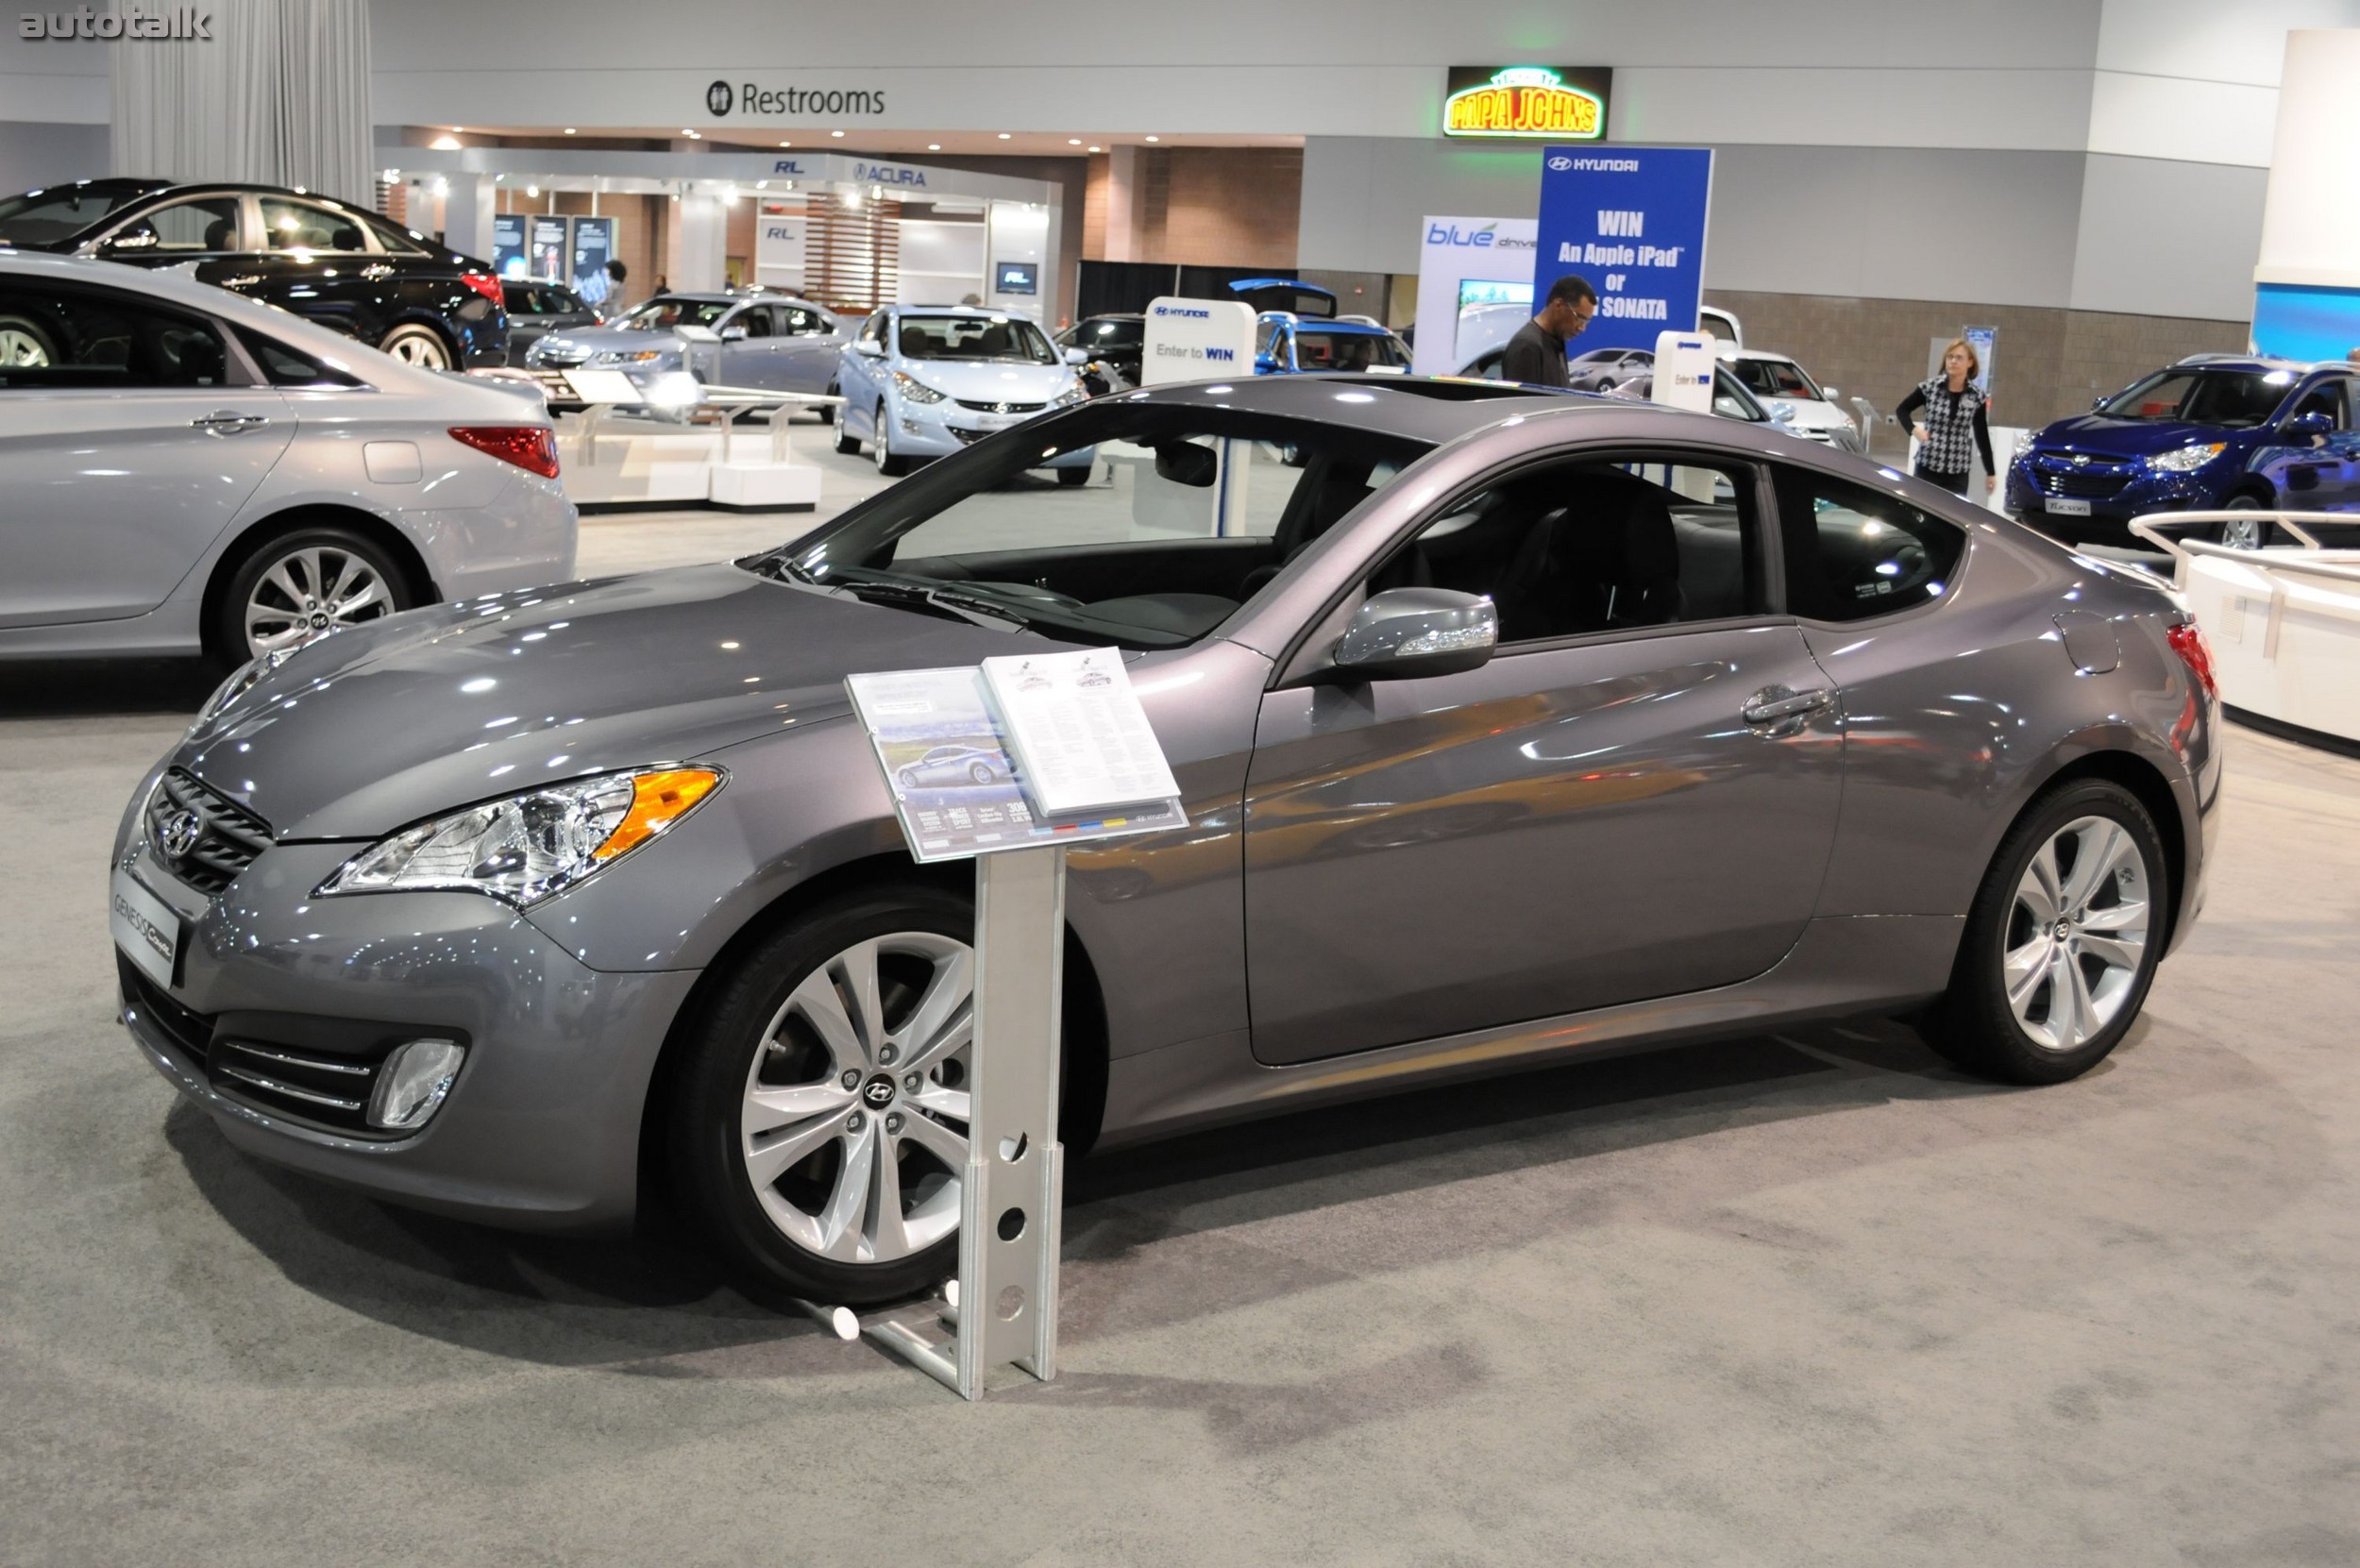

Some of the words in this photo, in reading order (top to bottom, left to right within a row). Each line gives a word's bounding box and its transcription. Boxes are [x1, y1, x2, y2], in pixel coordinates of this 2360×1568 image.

[742, 83, 885, 114] Restrooms
[1449, 89, 1513, 130] PAPA
[774, 160, 805, 174] RL
[868, 165, 927, 187] ACURA
[1573, 159, 1639, 172] HYUNDAI
[767, 228, 796, 240] RL
[1426, 223, 1495, 246] blue
[1597, 210, 1644, 238] WIN
[1558, 242, 1582, 263] An
[1583, 243, 1635, 267] Apple
[1605, 273, 1627, 292] or
[1602, 296, 1668, 320] SONATA
[1156, 343, 1188, 358] Enter
[1190, 347, 1204, 359] to
[1205, 346, 1234, 362] WIN
[114, 893, 149, 936] GENESIS
[147, 927, 172, 956] Coupe
